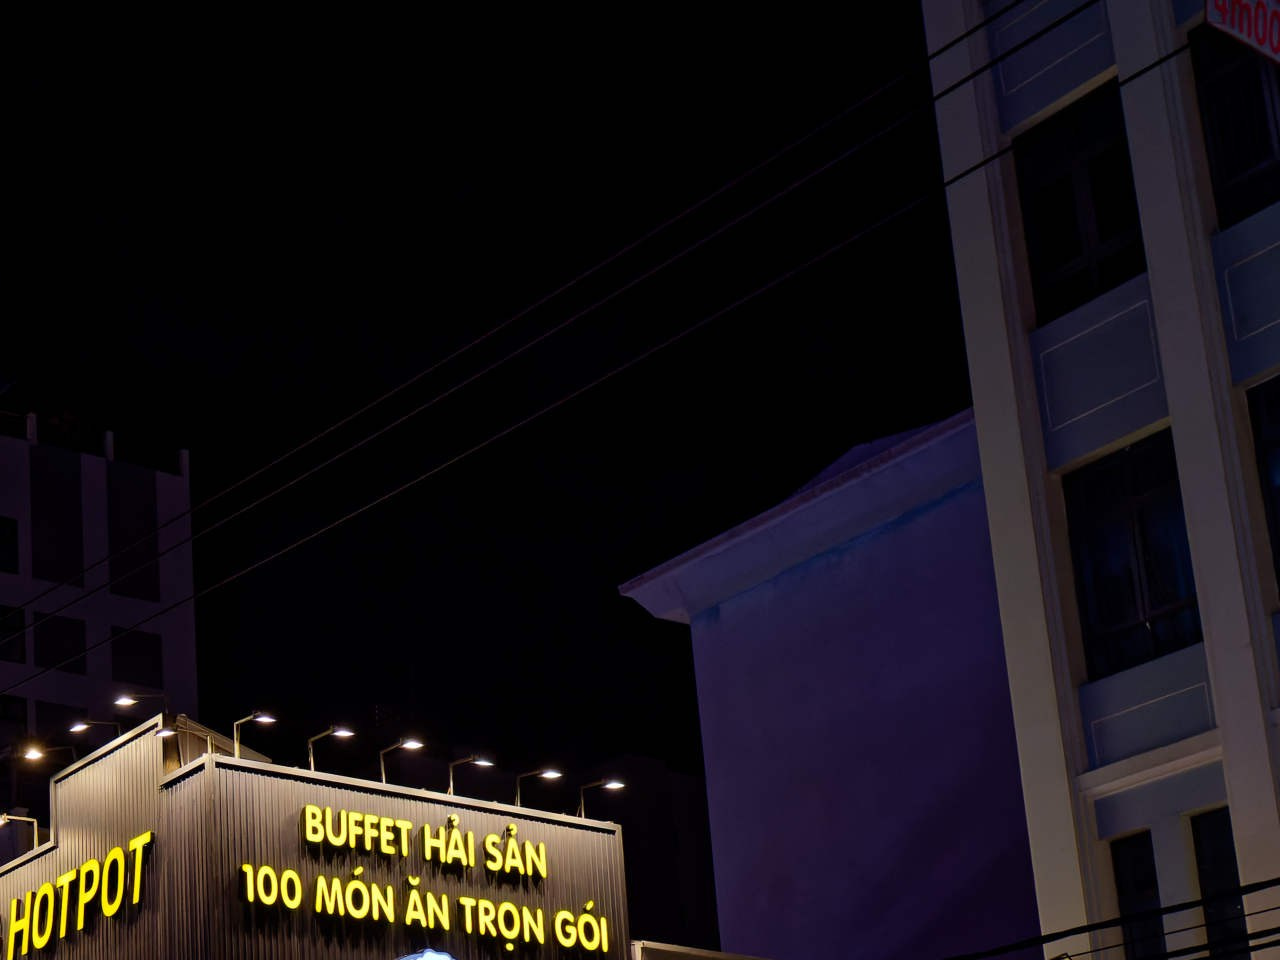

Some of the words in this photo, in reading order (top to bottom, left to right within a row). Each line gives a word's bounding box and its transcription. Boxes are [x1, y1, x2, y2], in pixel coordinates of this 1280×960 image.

[303, 804, 413, 857] BUFFET
[424, 813, 475, 867] HẢI
[485, 823, 548, 879] SẢN
[242, 863, 302, 909] 100
[315, 866, 394, 923] MÓN
[405, 876, 450, 931] ĂN
[459, 896, 545, 951] TRỌN
[554, 900, 609, 953] GÓI
